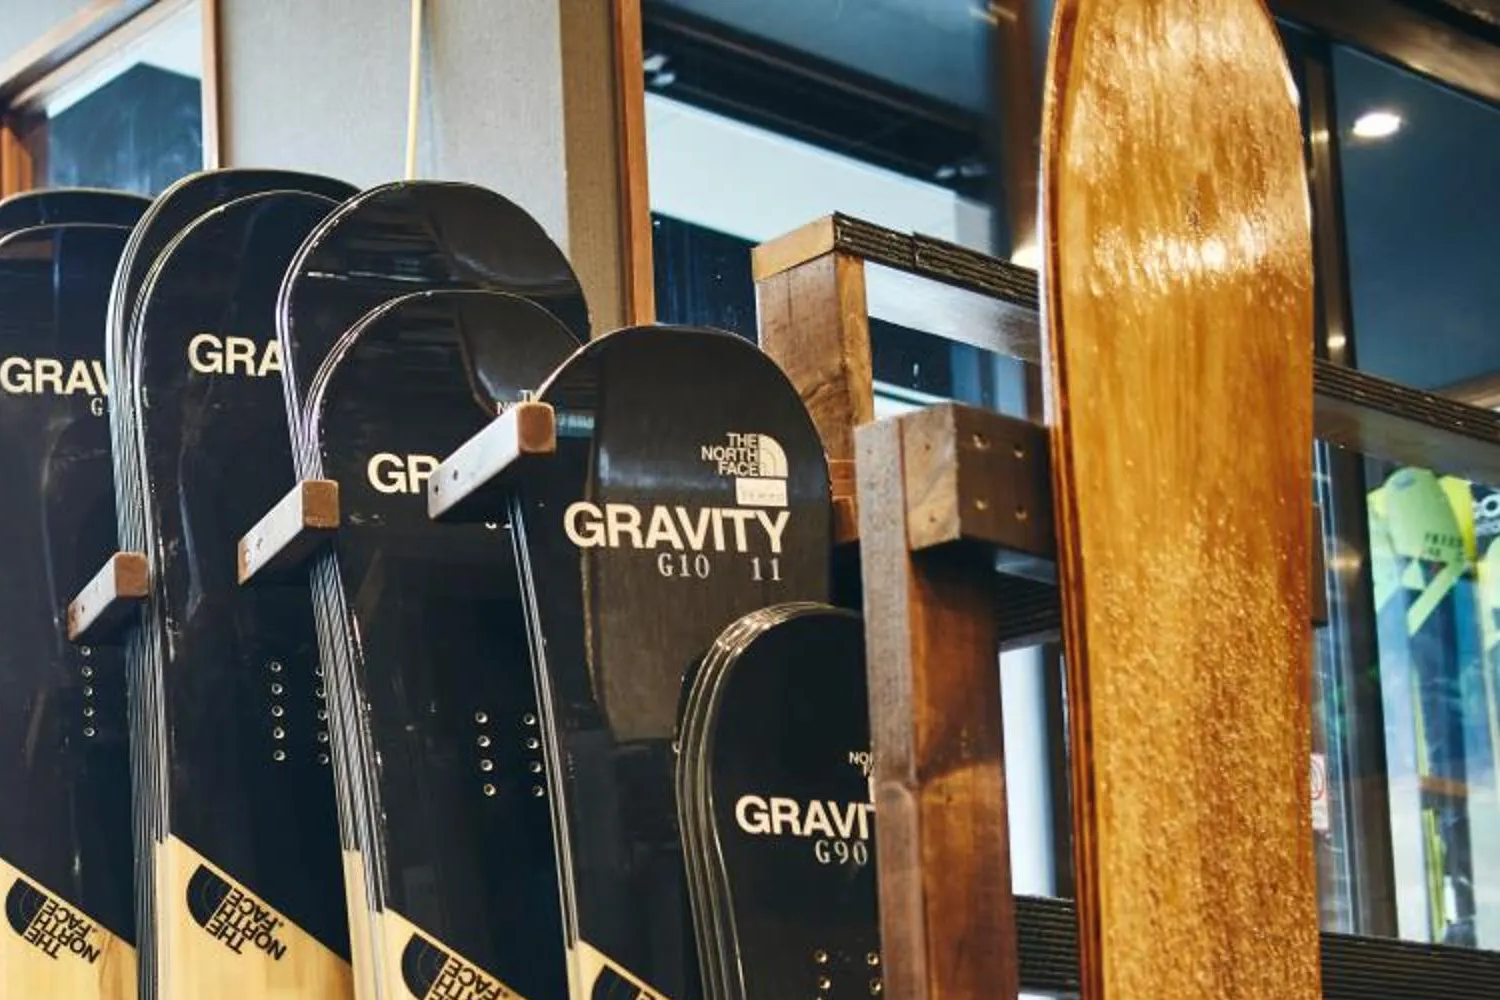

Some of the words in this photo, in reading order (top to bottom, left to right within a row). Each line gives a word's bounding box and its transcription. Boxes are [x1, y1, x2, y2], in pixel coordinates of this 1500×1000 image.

[701, 446, 757, 461] NORTH
[726, 432, 758, 449] THE
[718, 461, 759, 477] FACE
[563, 501, 791, 553] GRAVITY
[657, 552, 710, 579] G10
[815, 840, 868, 866] G90
[42, 898, 92, 937] FACE
[226, 888, 278, 932] FACE
[24, 926, 60, 959] THE
[33, 912, 100, 964] NORTH
[206, 918, 244, 954] THE
[216, 903, 287, 961] NORTH
